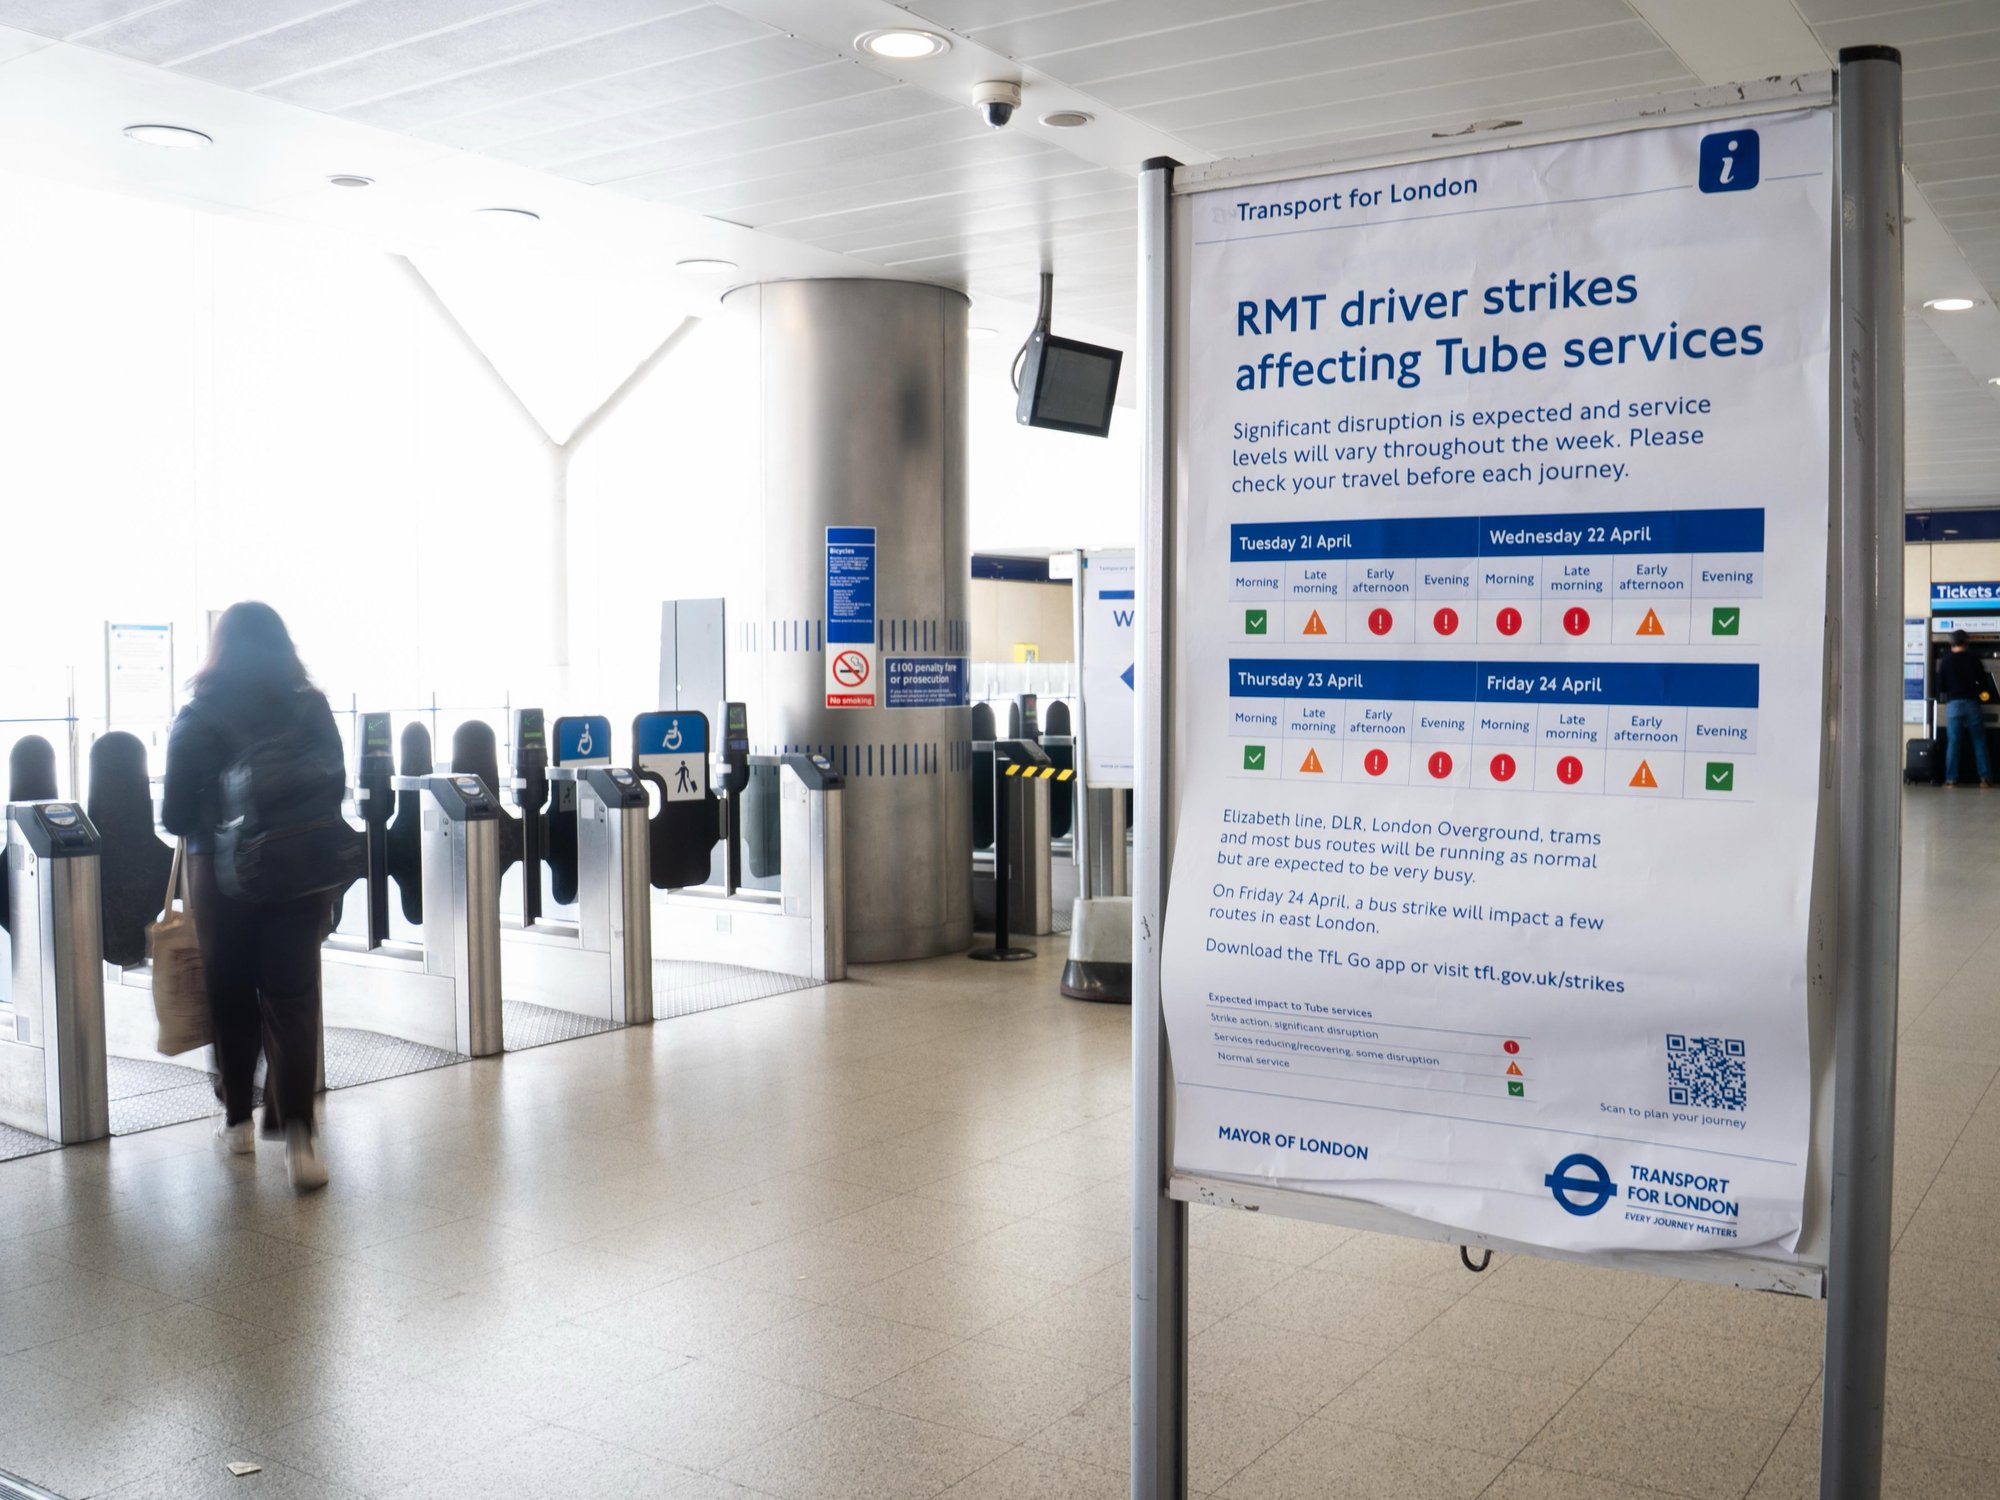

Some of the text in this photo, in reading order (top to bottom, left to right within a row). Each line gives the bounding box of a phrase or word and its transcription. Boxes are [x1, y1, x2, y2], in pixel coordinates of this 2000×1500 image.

[1236, 177, 1478, 221] Transport for London
[1237, 270, 1638, 337] RMT driver strikes
[1236, 321, 1764, 391] affecting Tube services
[1233, 396, 1711, 443] Significant disruption is expected and service
[1233, 427, 1704, 466] levels will vary throughout the week. Please
[1232, 463, 1629, 495] check your travel before each journey.
[1239, 533, 1352, 553] Tuesday 21 April
[1489, 526, 1652, 546] Wednesday 22 April
[830, 547, 854, 555] Bicycles
[1304, 570, 1327, 580] Late
[1367, 568, 1395, 581] Early
[1564, 565, 1590, 576] Late
[1636, 564, 1668, 578] Early
[1702, 570, 1753, 584] Evening
[1235, 577, 1279, 589] Morning
[1424, 574, 1470, 587] Evening
[1485, 573, 1535, 586] Morning
[1551, 580, 1603, 593] morning
[1619, 579, 1684, 590] afternoon
[1293, 583, 1338, 595] morning
[1352, 582, 1409, 593] afternoon
[1937, 585, 1992, 598] Tickets
[890, 662, 957, 674] £100 penalty fare
[890, 675, 949, 685] or prosecution
[1238, 671, 1363, 691] Thursday 23 April
[1487, 675, 1602, 695] Friday 24 April
[842, 696, 872, 705] smoking
[1235, 712, 1278, 726] Morning
[1303, 707, 1326, 718] Late
[1365, 709, 1393, 722] Early
[1559, 713, 1586, 725] Late
[1291, 722, 1336, 734] morning
[1350, 722, 1406, 734] afternoon
[1421, 717, 1465, 731] Evening
[1480, 719, 1530, 733] Morning
[1631, 715, 1663, 730] Early
[1545, 729, 1598, 743] morning
[1614, 730, 1678, 743] afternoon
[1696, 724, 1748, 740] Evening
[1223, 808, 1601, 845] Elizabeth line, DLR, London Overground, trams
[1220, 831, 1597, 869] and most bus routes will be running as normal
[1217, 850, 1475, 886] but are expected to be very busy.
[1212, 883, 1604, 930] On Friday 24 April, a bus strike will impact a few
[1209, 907, 1379, 934] routes in east London.
[1206, 937, 1625, 993] Download the TfL Go app or visit tfl.gov.uk/strikes
[1208, 992, 1373, 1018] Expected impact to Tube services
[1210, 1012, 1379, 1039] Strike action, significant disruption
[1214, 1032, 1253, 1045] Services
[1356, 1050, 1384, 1060] some
[1386, 1052, 1440, 1065] disruption
[1217, 1051, 1290, 1068] Normal service
[1600, 1102, 1747, 1130] Scan to plan your journey
[1218, 1126, 1368, 1160] MAYOR OF LONDON
[1630, 1164, 1730, 1195] TRANSPORT
[1628, 1186, 1739, 1217] FOR LONDON
[1624, 1212, 1738, 1238] EVERY JOURNEY MATTERS
